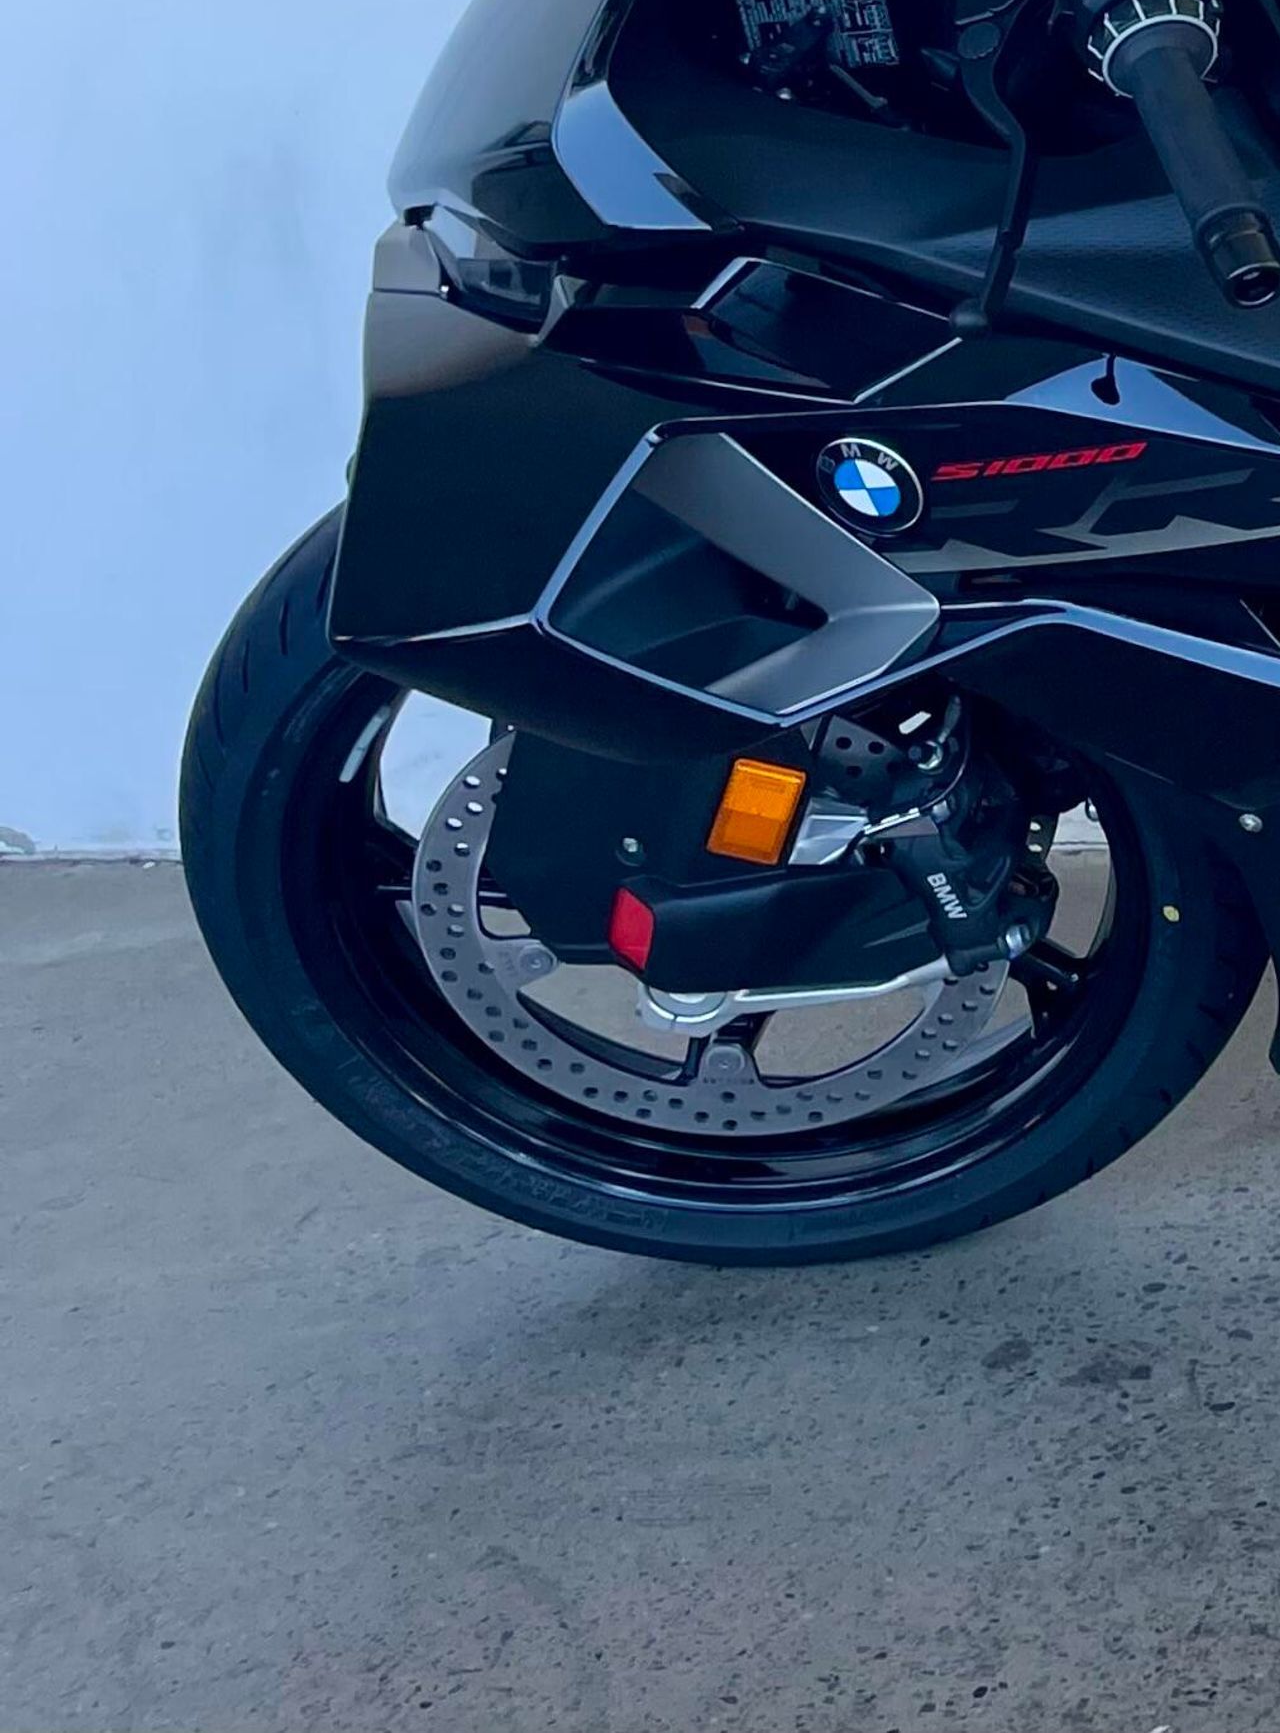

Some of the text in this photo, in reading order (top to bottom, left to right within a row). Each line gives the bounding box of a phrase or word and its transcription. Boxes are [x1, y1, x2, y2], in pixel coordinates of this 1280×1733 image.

[820, 442, 899, 475] BMW
[930, 441, 1147, 481] S1000
[926, 872, 968, 919] BMW
